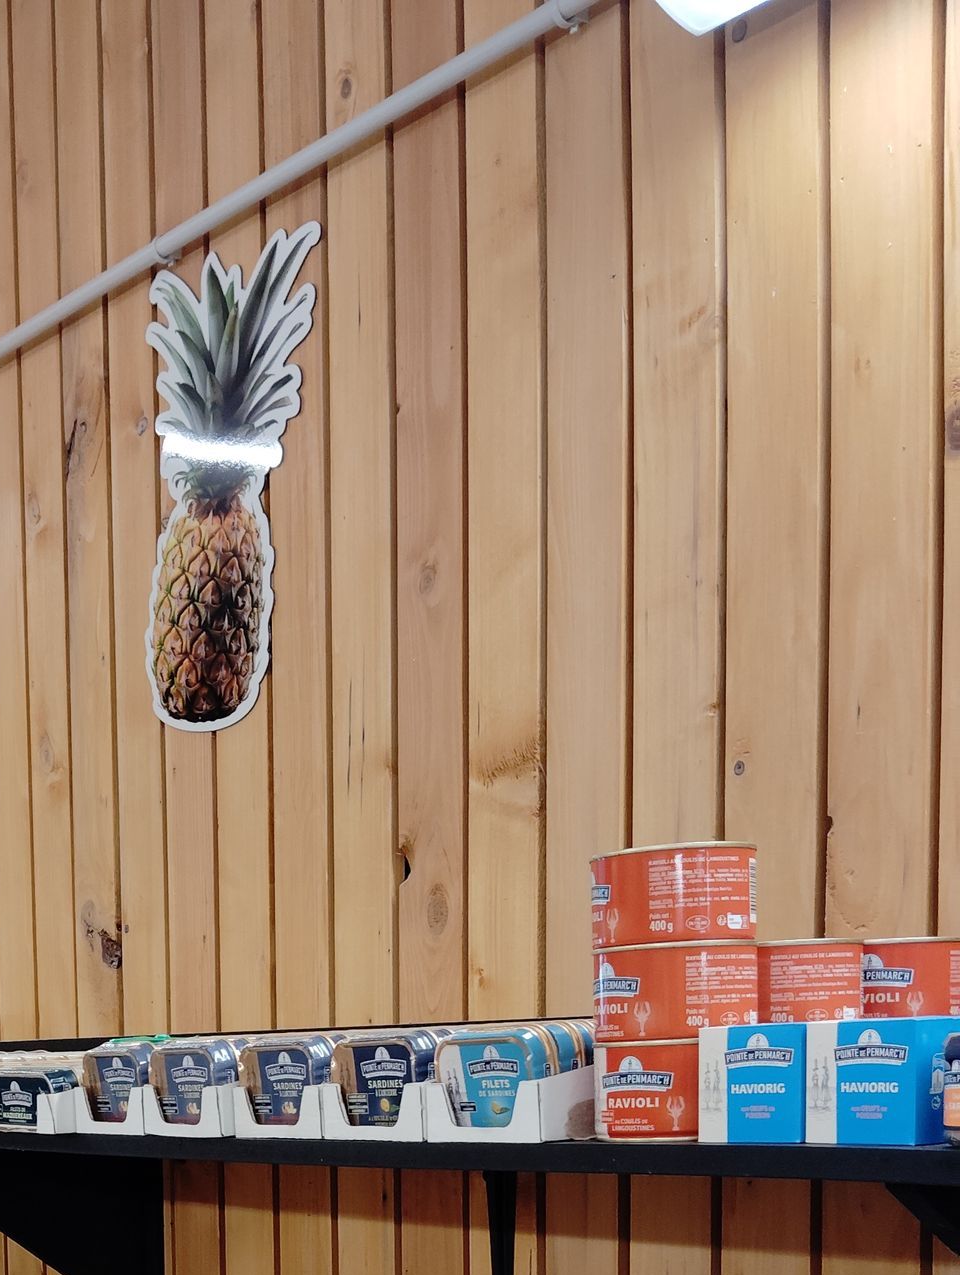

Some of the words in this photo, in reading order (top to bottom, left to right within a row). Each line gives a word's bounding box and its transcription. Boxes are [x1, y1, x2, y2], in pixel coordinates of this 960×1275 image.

[649, 921, 666, 932] 400
[667, 922, 674, 933] g
[866, 970, 910, 981] PENMARC'H
[862, 992, 900, 1004] VIOLI
[686, 1016, 703, 1026] 400
[770, 1013, 788, 1022] 400
[726, 1051, 747, 1063] POINTE
[754, 1050, 790, 1061] PENMARC'H
[836, 1048, 859, 1060] POINTE
[866, 1047, 905, 1059] PENMARC'H
[272, 1082, 302, 1090] SARDINES
[368, 1079, 403, 1089] SARDINES
[482, 1080, 510, 1089] FILETS
[603, 1075, 621, 1088] POINTE
[621, 1075, 627, 1083] DE
[627, 1073, 670, 1085] PENMARC'H
[730, 1083, 785, 1095] HAVIORIG
[840, 1082, 899, 1093] HAVIORIG
[608, 1097, 659, 1109] RAVIOLI
